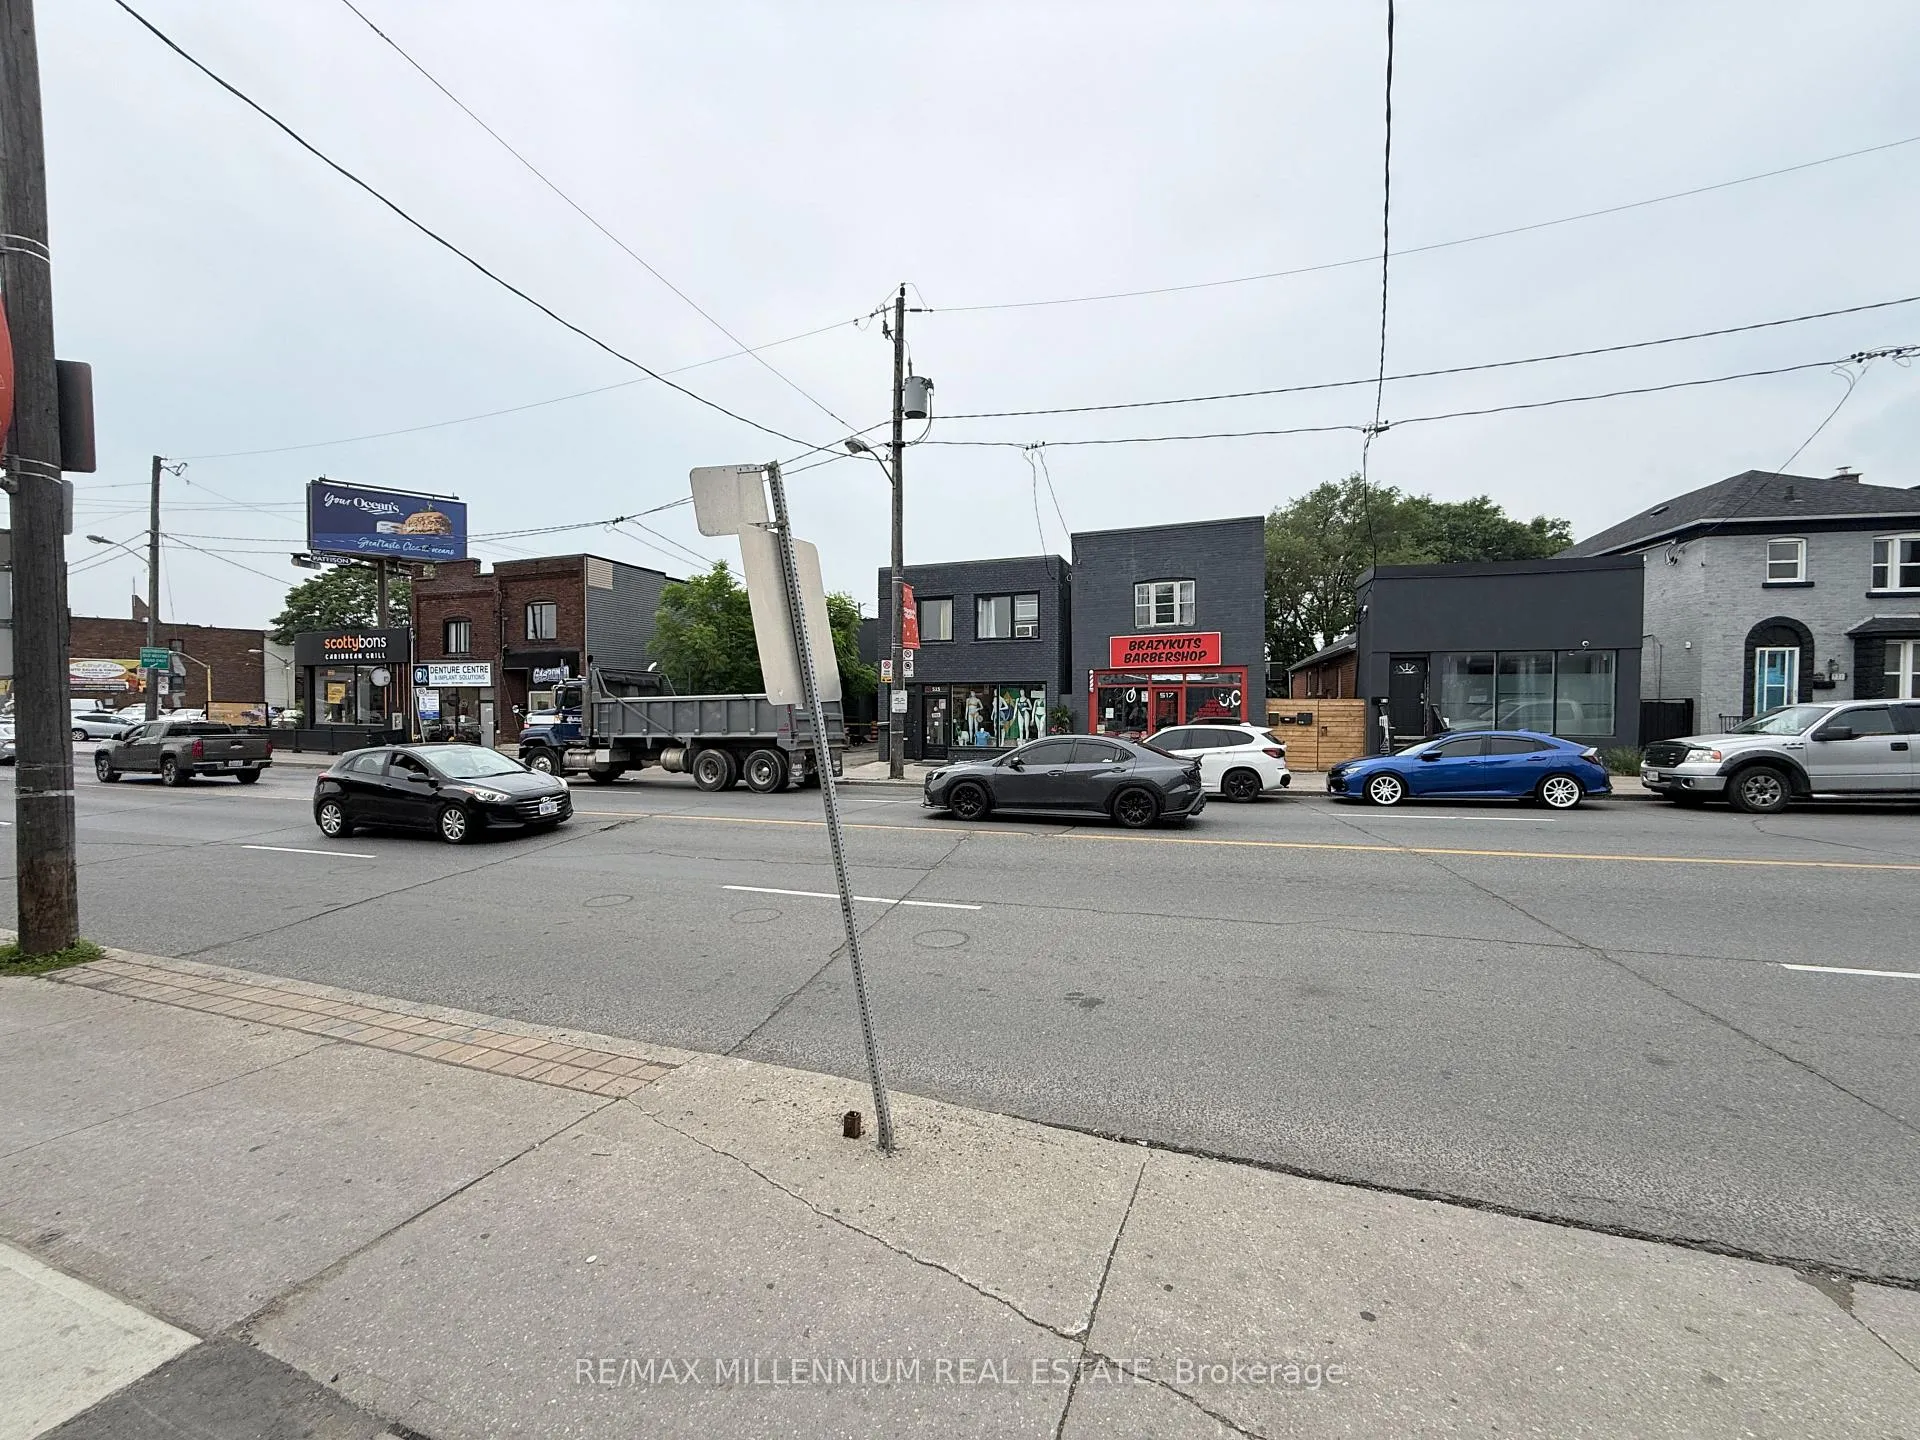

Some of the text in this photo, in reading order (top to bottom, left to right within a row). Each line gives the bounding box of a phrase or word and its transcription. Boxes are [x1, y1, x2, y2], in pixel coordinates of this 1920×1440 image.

[324, 492, 400, 514] Your Ocean's
[312, 555, 349, 565] PATTISON
[324, 634, 387, 652] scottybons
[1129, 637, 1202, 652] BRAZYKUTS
[325, 652, 363, 660] CARIBBEAN
[1123, 650, 1207, 664] BARBERSHOP
[430, 665, 489, 674] DENTURE CENTRE
